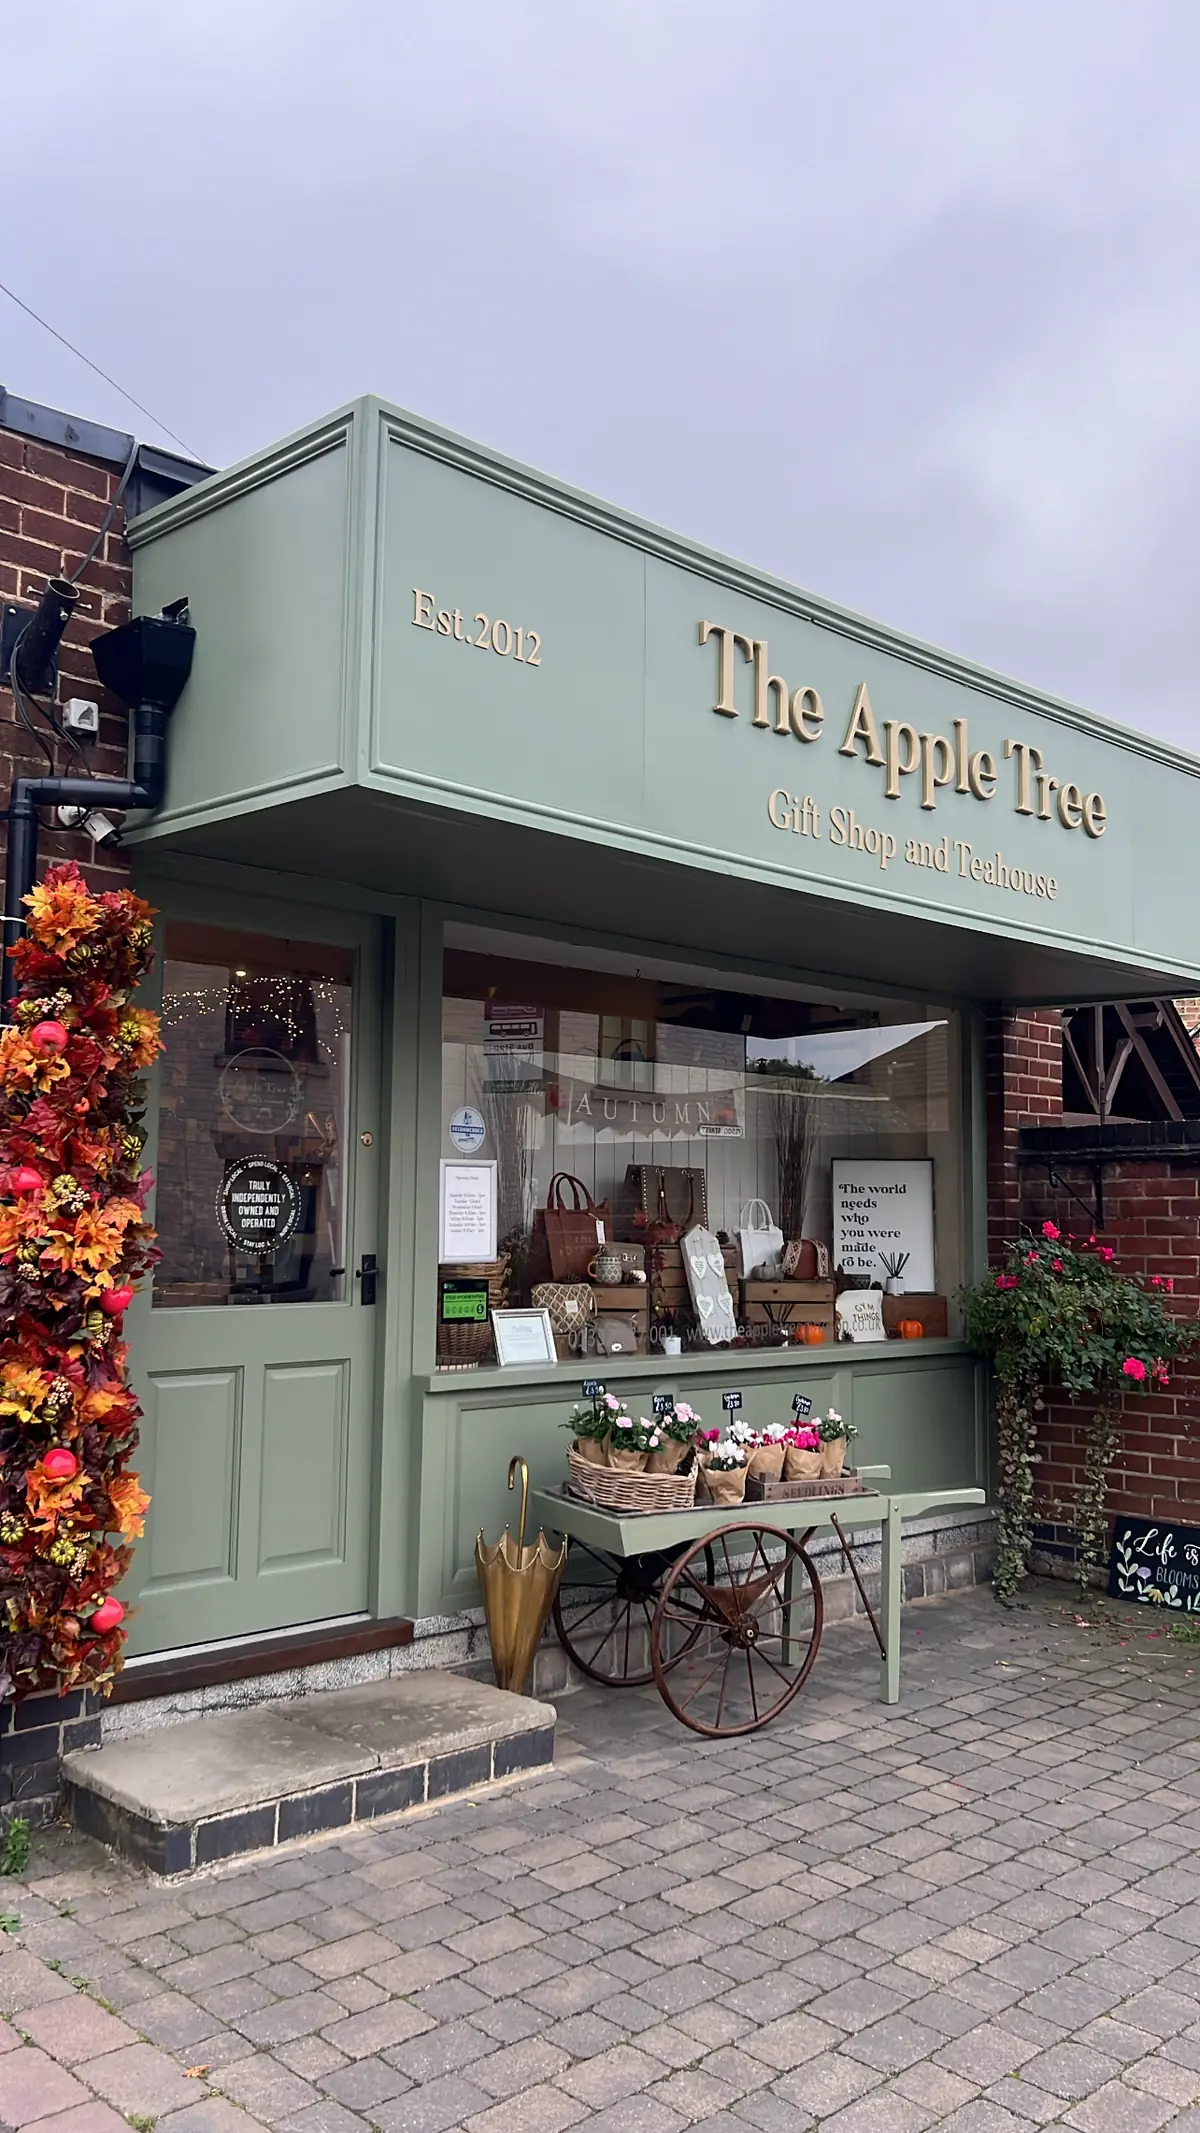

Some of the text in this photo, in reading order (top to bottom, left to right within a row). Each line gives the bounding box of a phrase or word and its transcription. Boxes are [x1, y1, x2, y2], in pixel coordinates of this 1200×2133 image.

[411, 588, 541, 667] Est.2012
[698, 620, 1108, 838] The Apple Tree
[767, 789, 1058, 900] Gift Shop and Teahouse
[575, 1092, 711, 1124] AUTUMN
[264, 1161, 279, 1172] LOCAL
[222, 1168, 244, 1196] SHOP LOCAL
[248, 1180, 271, 1190] TRULY
[286, 1182, 295, 1200] LOCAL
[838, 1184, 906, 1194] The world
[232, 1193, 286, 1203] INDEPENDENTLY
[840, 1198, 877, 1210] needs
[238, 1206, 280, 1216] OWNED AND
[241, 1218, 276, 1228] OPERATED
[286, 1209, 296, 1226] LOCAL
[840, 1213, 869, 1225] who
[225, 1222, 238, 1239] LOCAL
[840, 1230, 901, 1240] you were
[243, 1239, 271, 1248] STAY LOCL
[842, 1242, 876, 1252] made
[842, 1256, 876, 1267] to be.
[854, 1302, 874, 1312] GYM
[853, 1312, 881, 1322] THINGS
[650, 1326, 674, 1344] 001
[1133, 1528, 1177, 1565] Life
[1156, 1566, 1200, 1589] BLOOMS
